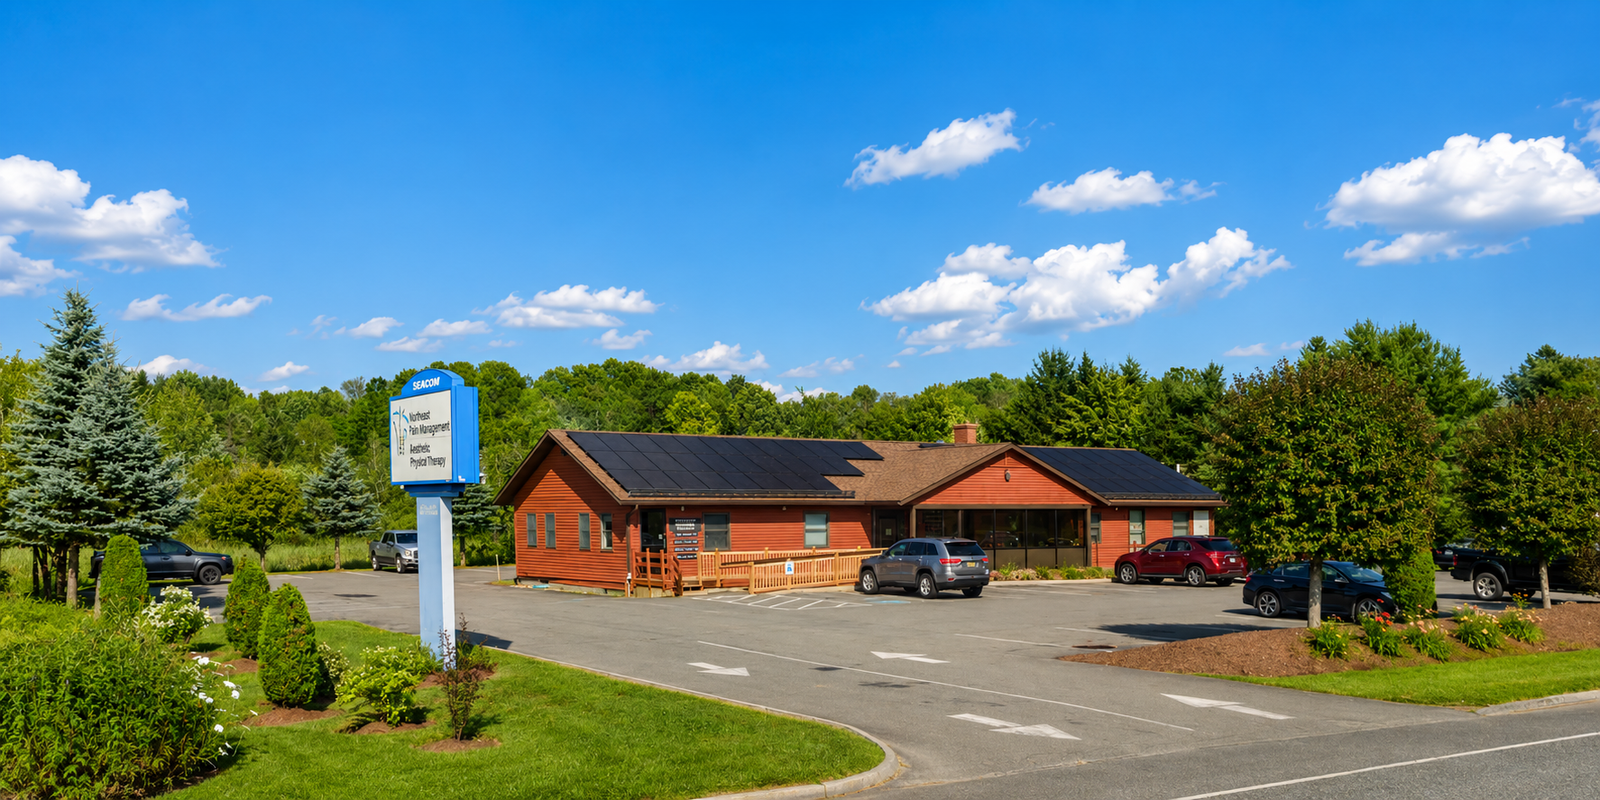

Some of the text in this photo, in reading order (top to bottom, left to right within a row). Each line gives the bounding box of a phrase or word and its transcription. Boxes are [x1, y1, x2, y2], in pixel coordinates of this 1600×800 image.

[409, 421, 450, 436] Pain Management
[410, 456, 446, 469] Physical Therapy
